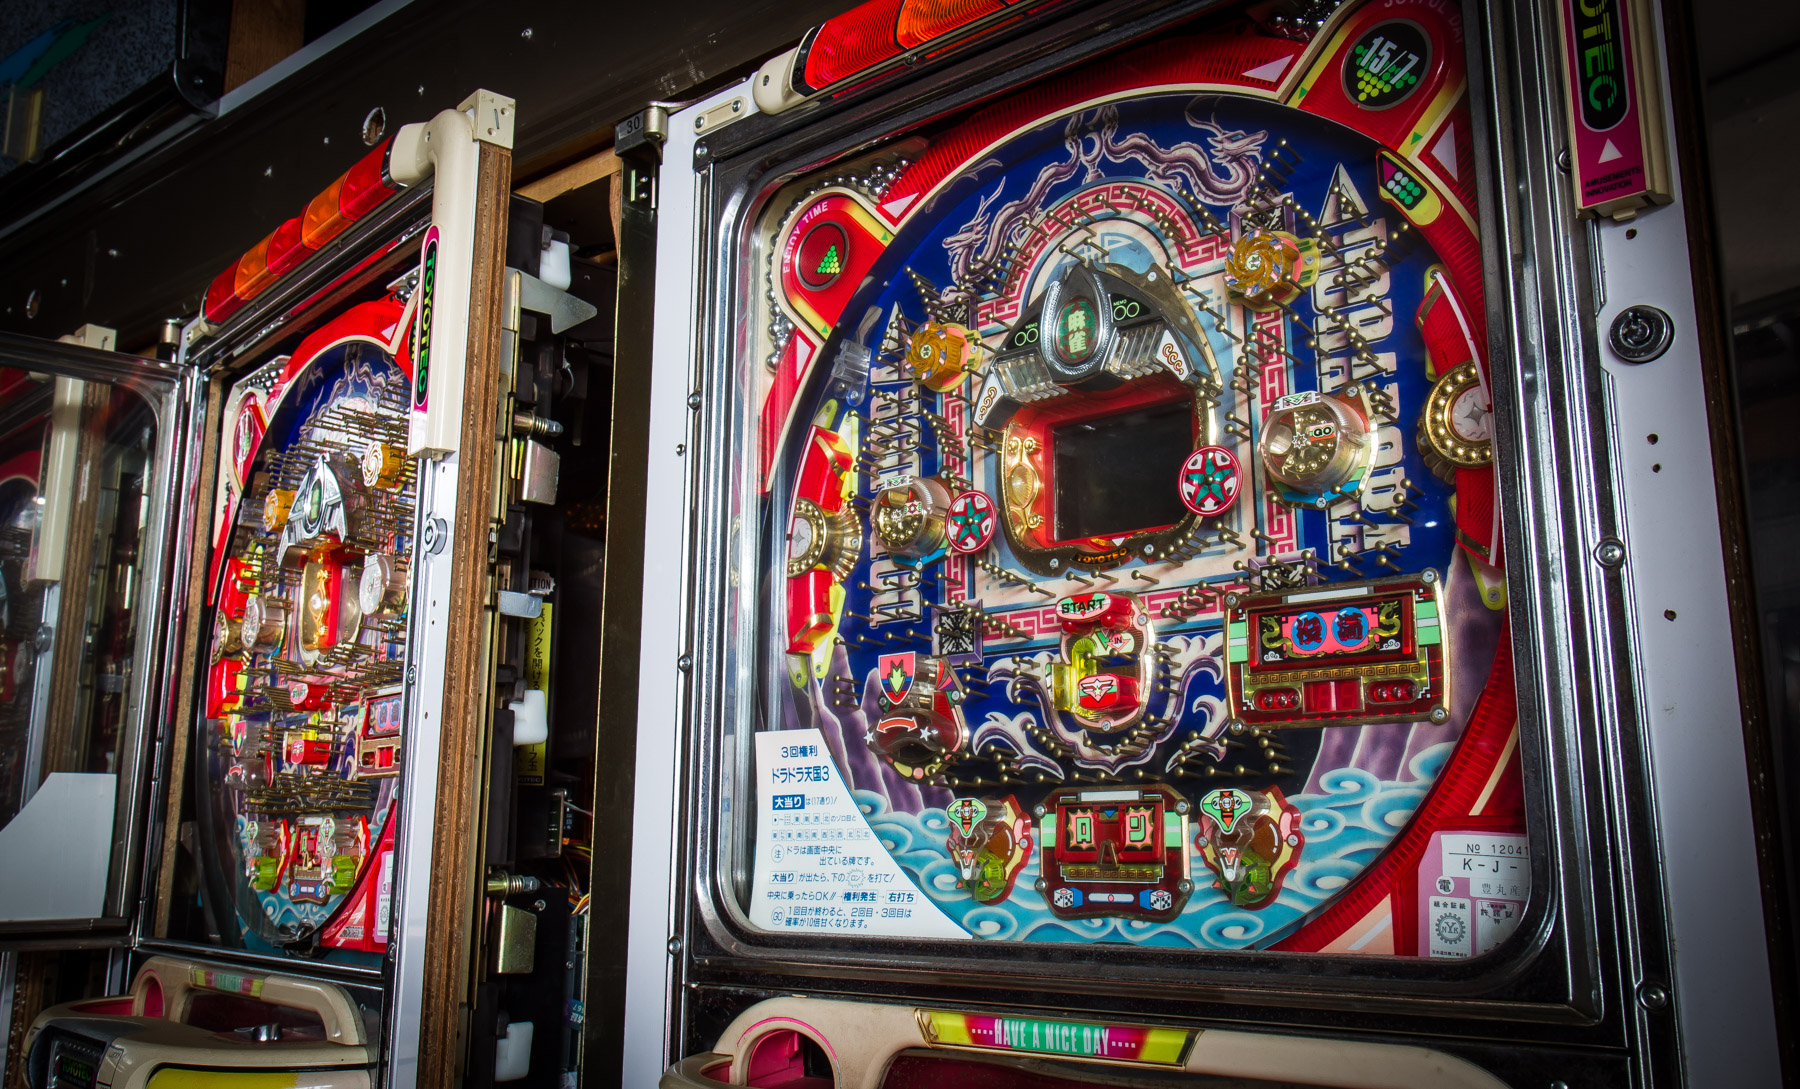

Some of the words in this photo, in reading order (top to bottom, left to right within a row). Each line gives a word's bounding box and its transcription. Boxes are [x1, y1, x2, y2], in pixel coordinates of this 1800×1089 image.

[1384, 0, 1445, 14] JUL
[1360, 36, 1420, 84] 15/7
[626, 116, 640, 134] 30
[1584, 166, 1641, 188] AMUSEMENTS
[1585, 178, 1632, 198] INNOVATION
[783, 226, 801, 274] ENJOY
[802, 201, 829, 224] TIME
[1113, 299, 1127, 307] MEMO
[418, 250, 436, 393] TOYOTEC
[1025, 322, 1038, 330] MEMO
[1061, 598, 1105, 614] START
[1114, 636, 1122, 644] IN
[781, 745, 818, 758] 3回権利
[772, 765, 830, 784] ドラドラ天国3
[774, 796, 802, 808] 大当り
[771, 873, 795, 883] 大当り
[843, 891, 877, 902] 権利発生
[888, 892, 915, 903] 右打ち
[994, 1018, 1026, 1048] HAVE
[1032, 1022, 1040, 1048] A
[1045, 1023, 1077, 1052] NICE
[1083, 1027, 1109, 1055] DAY
